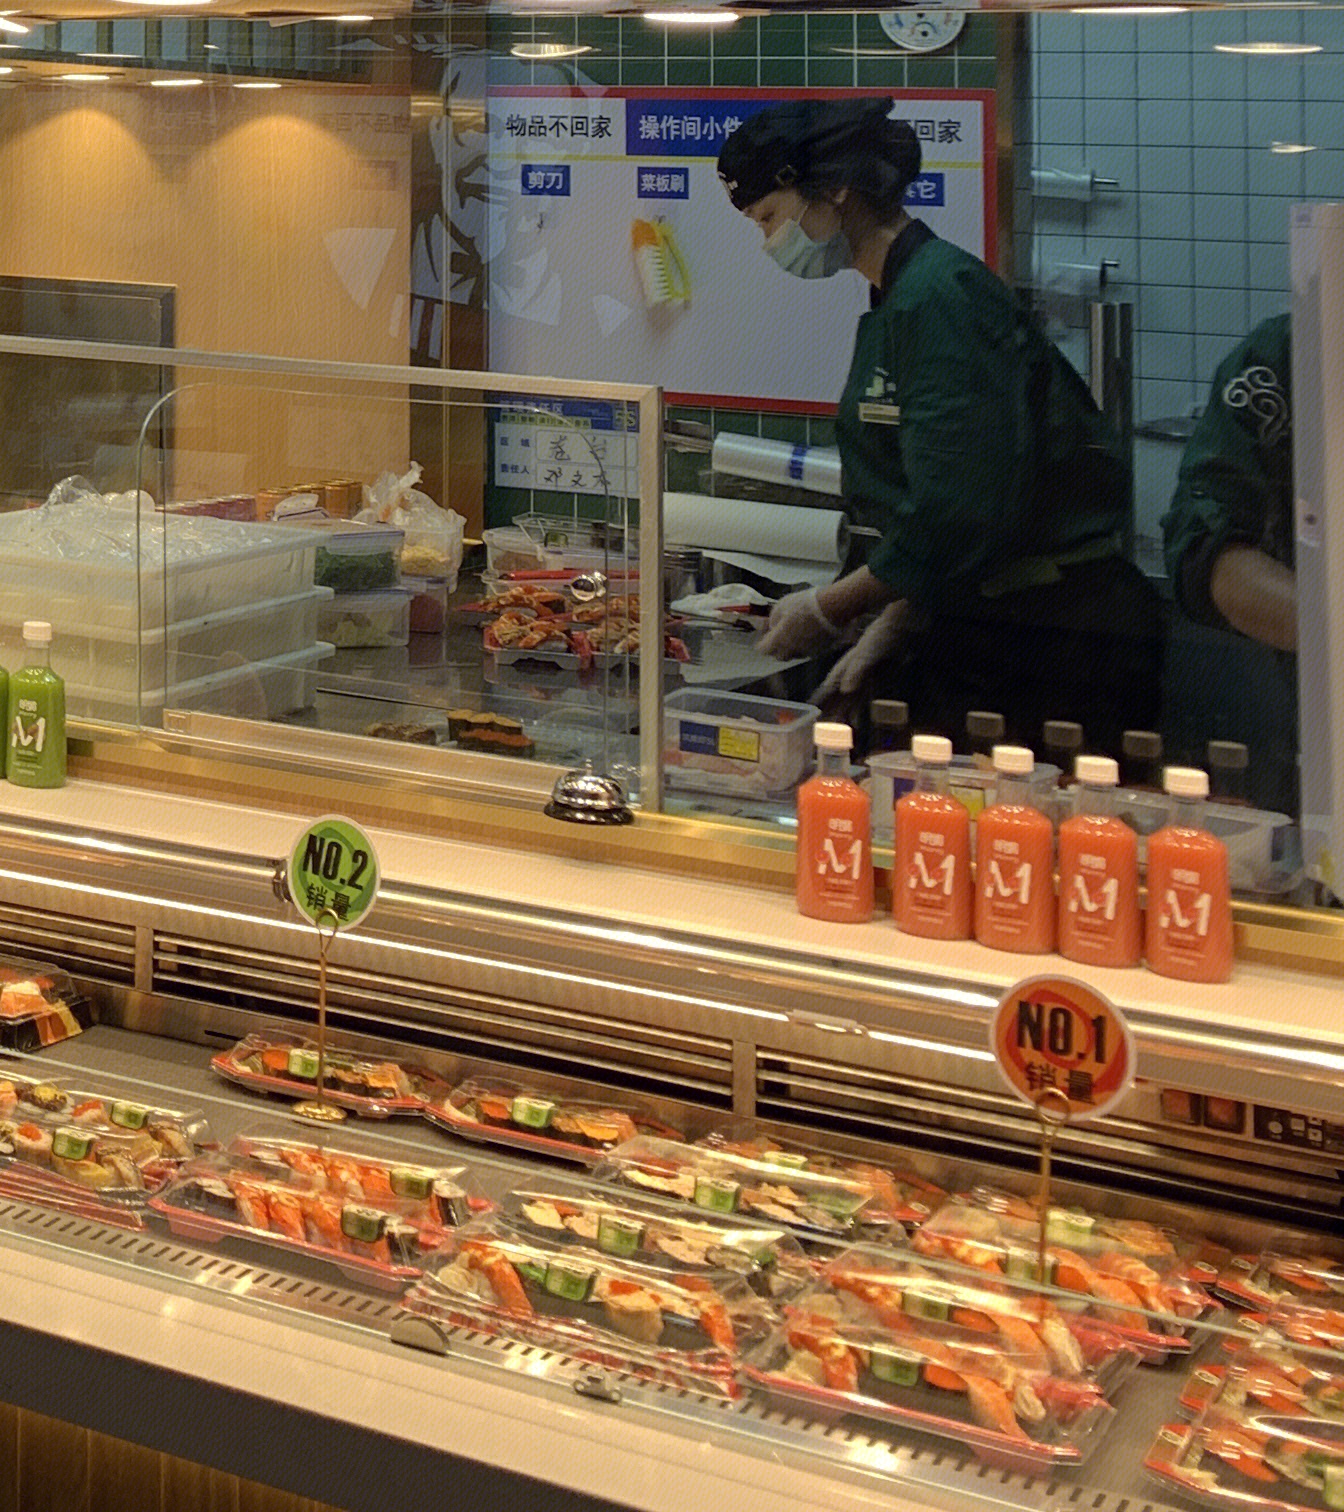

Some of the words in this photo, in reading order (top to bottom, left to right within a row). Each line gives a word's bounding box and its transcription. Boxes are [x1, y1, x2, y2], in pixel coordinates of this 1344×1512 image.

[506, 114, 613, 139] 物品不回家
[639, 114, 744, 141] 操作间小件
[908, 119, 963, 143] 回家
[527, 171, 563, 190] 剪刀
[641, 174, 685, 193] 菜板刷
[501, 463, 530, 475] 责任人
[302, 833, 369, 892] NO.2
[306, 883, 353, 921] 销量
[1016, 1000, 1107, 1065] NO.1
[1024, 1061, 1096, 1106] 销量
